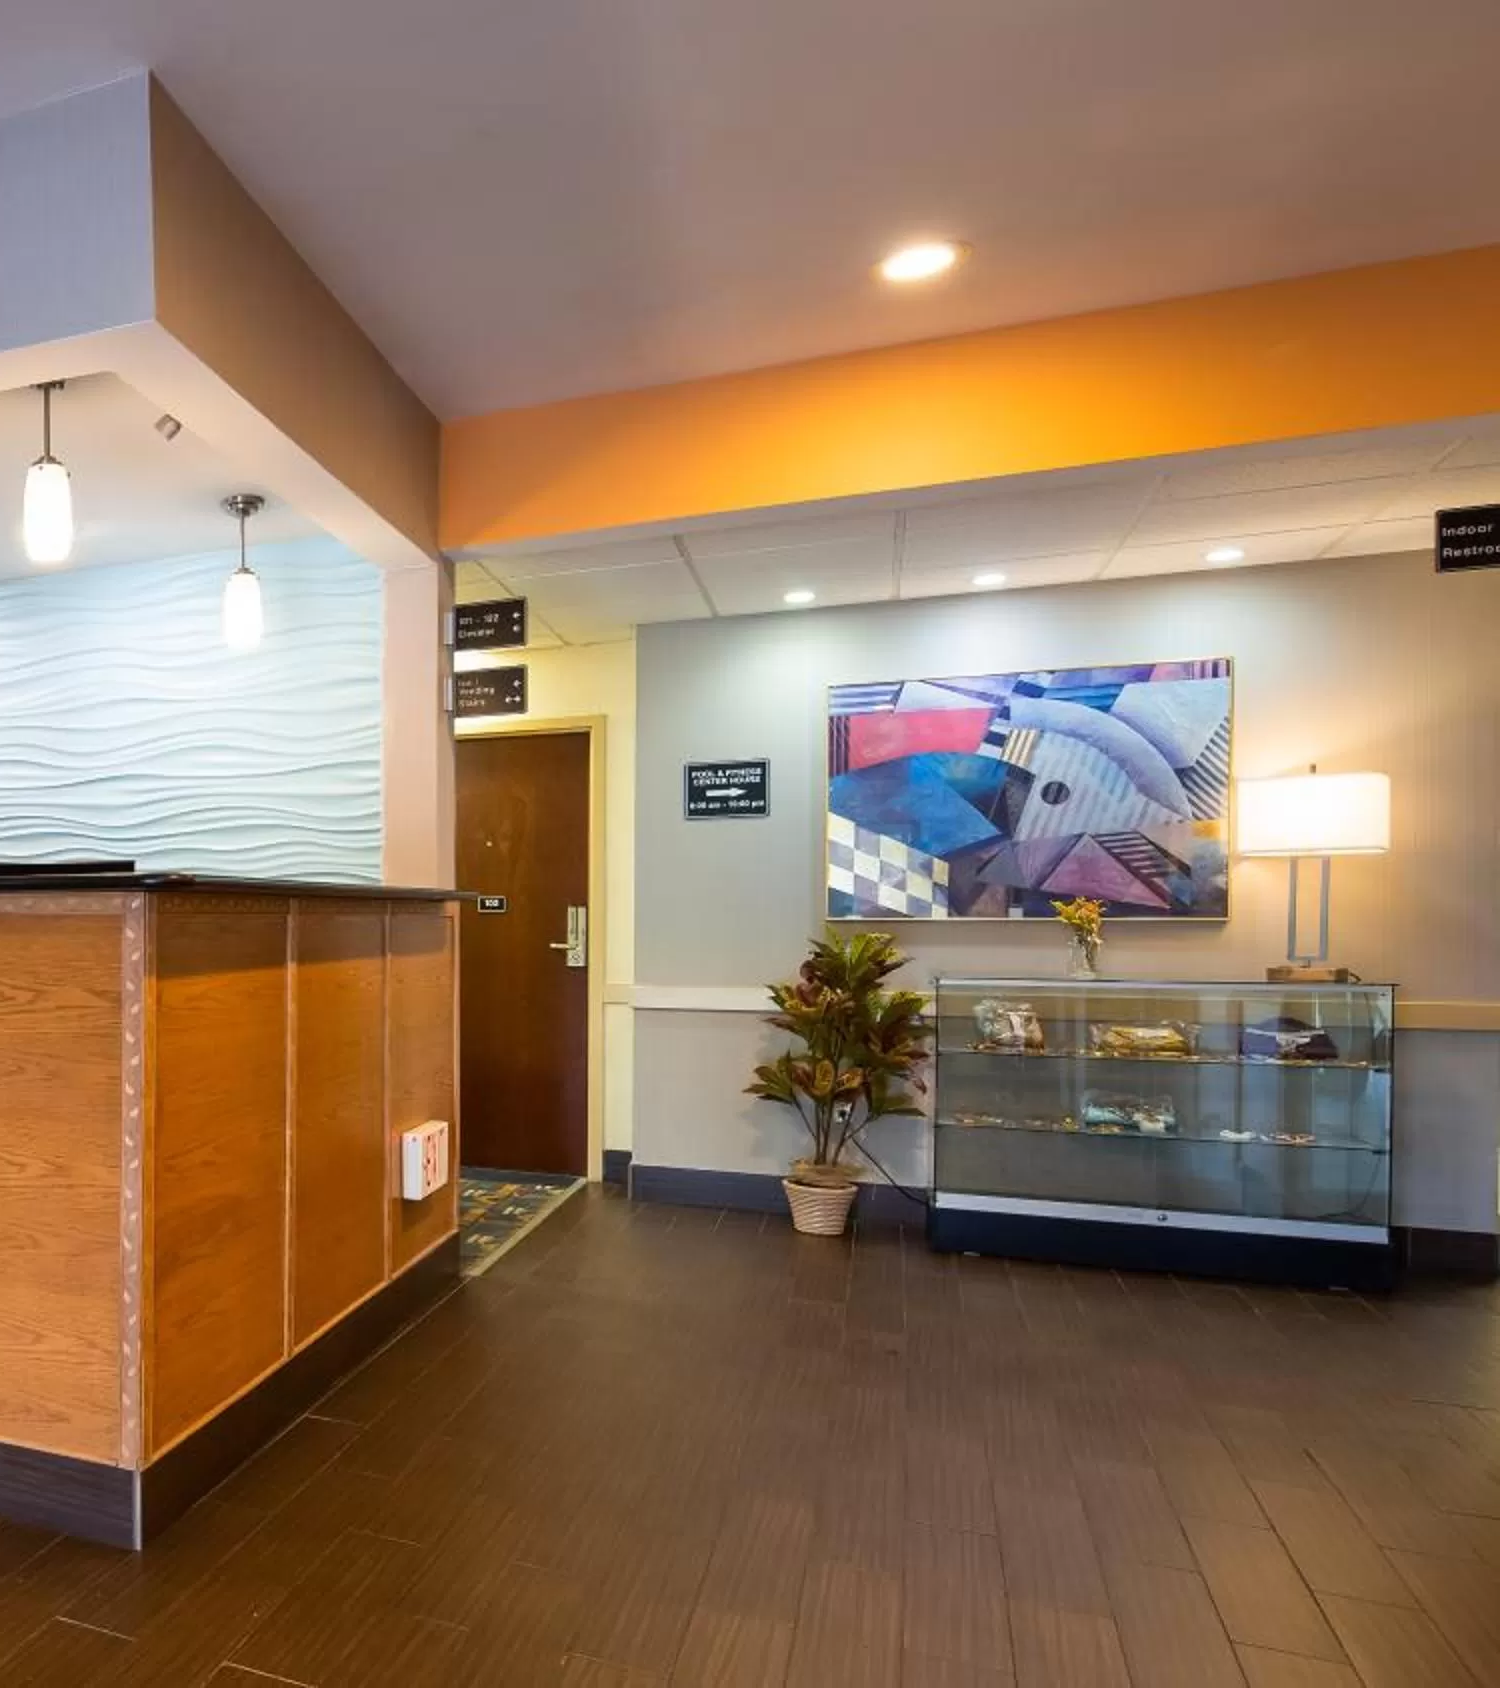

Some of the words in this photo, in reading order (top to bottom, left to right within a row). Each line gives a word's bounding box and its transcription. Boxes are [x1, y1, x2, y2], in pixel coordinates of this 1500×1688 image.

[1441, 524, 1495, 537] Indoor
[691, 771, 714, 780] POOL
[717, 769, 724, 777] &
[693, 777, 728, 786] CENTER
